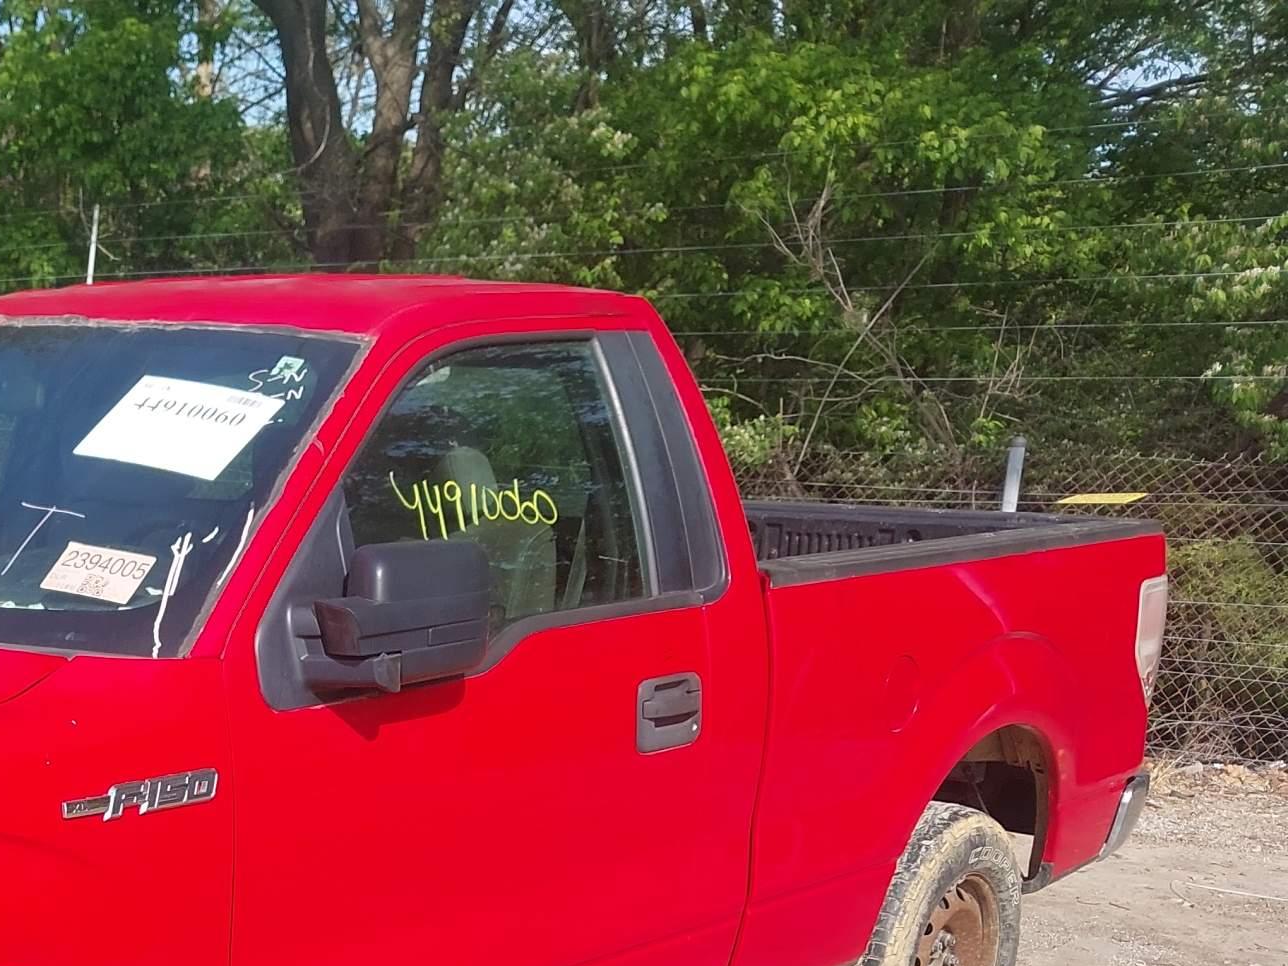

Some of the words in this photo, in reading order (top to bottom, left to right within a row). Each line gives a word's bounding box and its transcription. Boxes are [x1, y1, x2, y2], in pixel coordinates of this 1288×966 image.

[133, 396, 247, 426] 44910060
[389, 470, 559, 541] 44910060
[60, 549, 152, 580] 2394005
[968, 846, 1020, 906] COOPER
